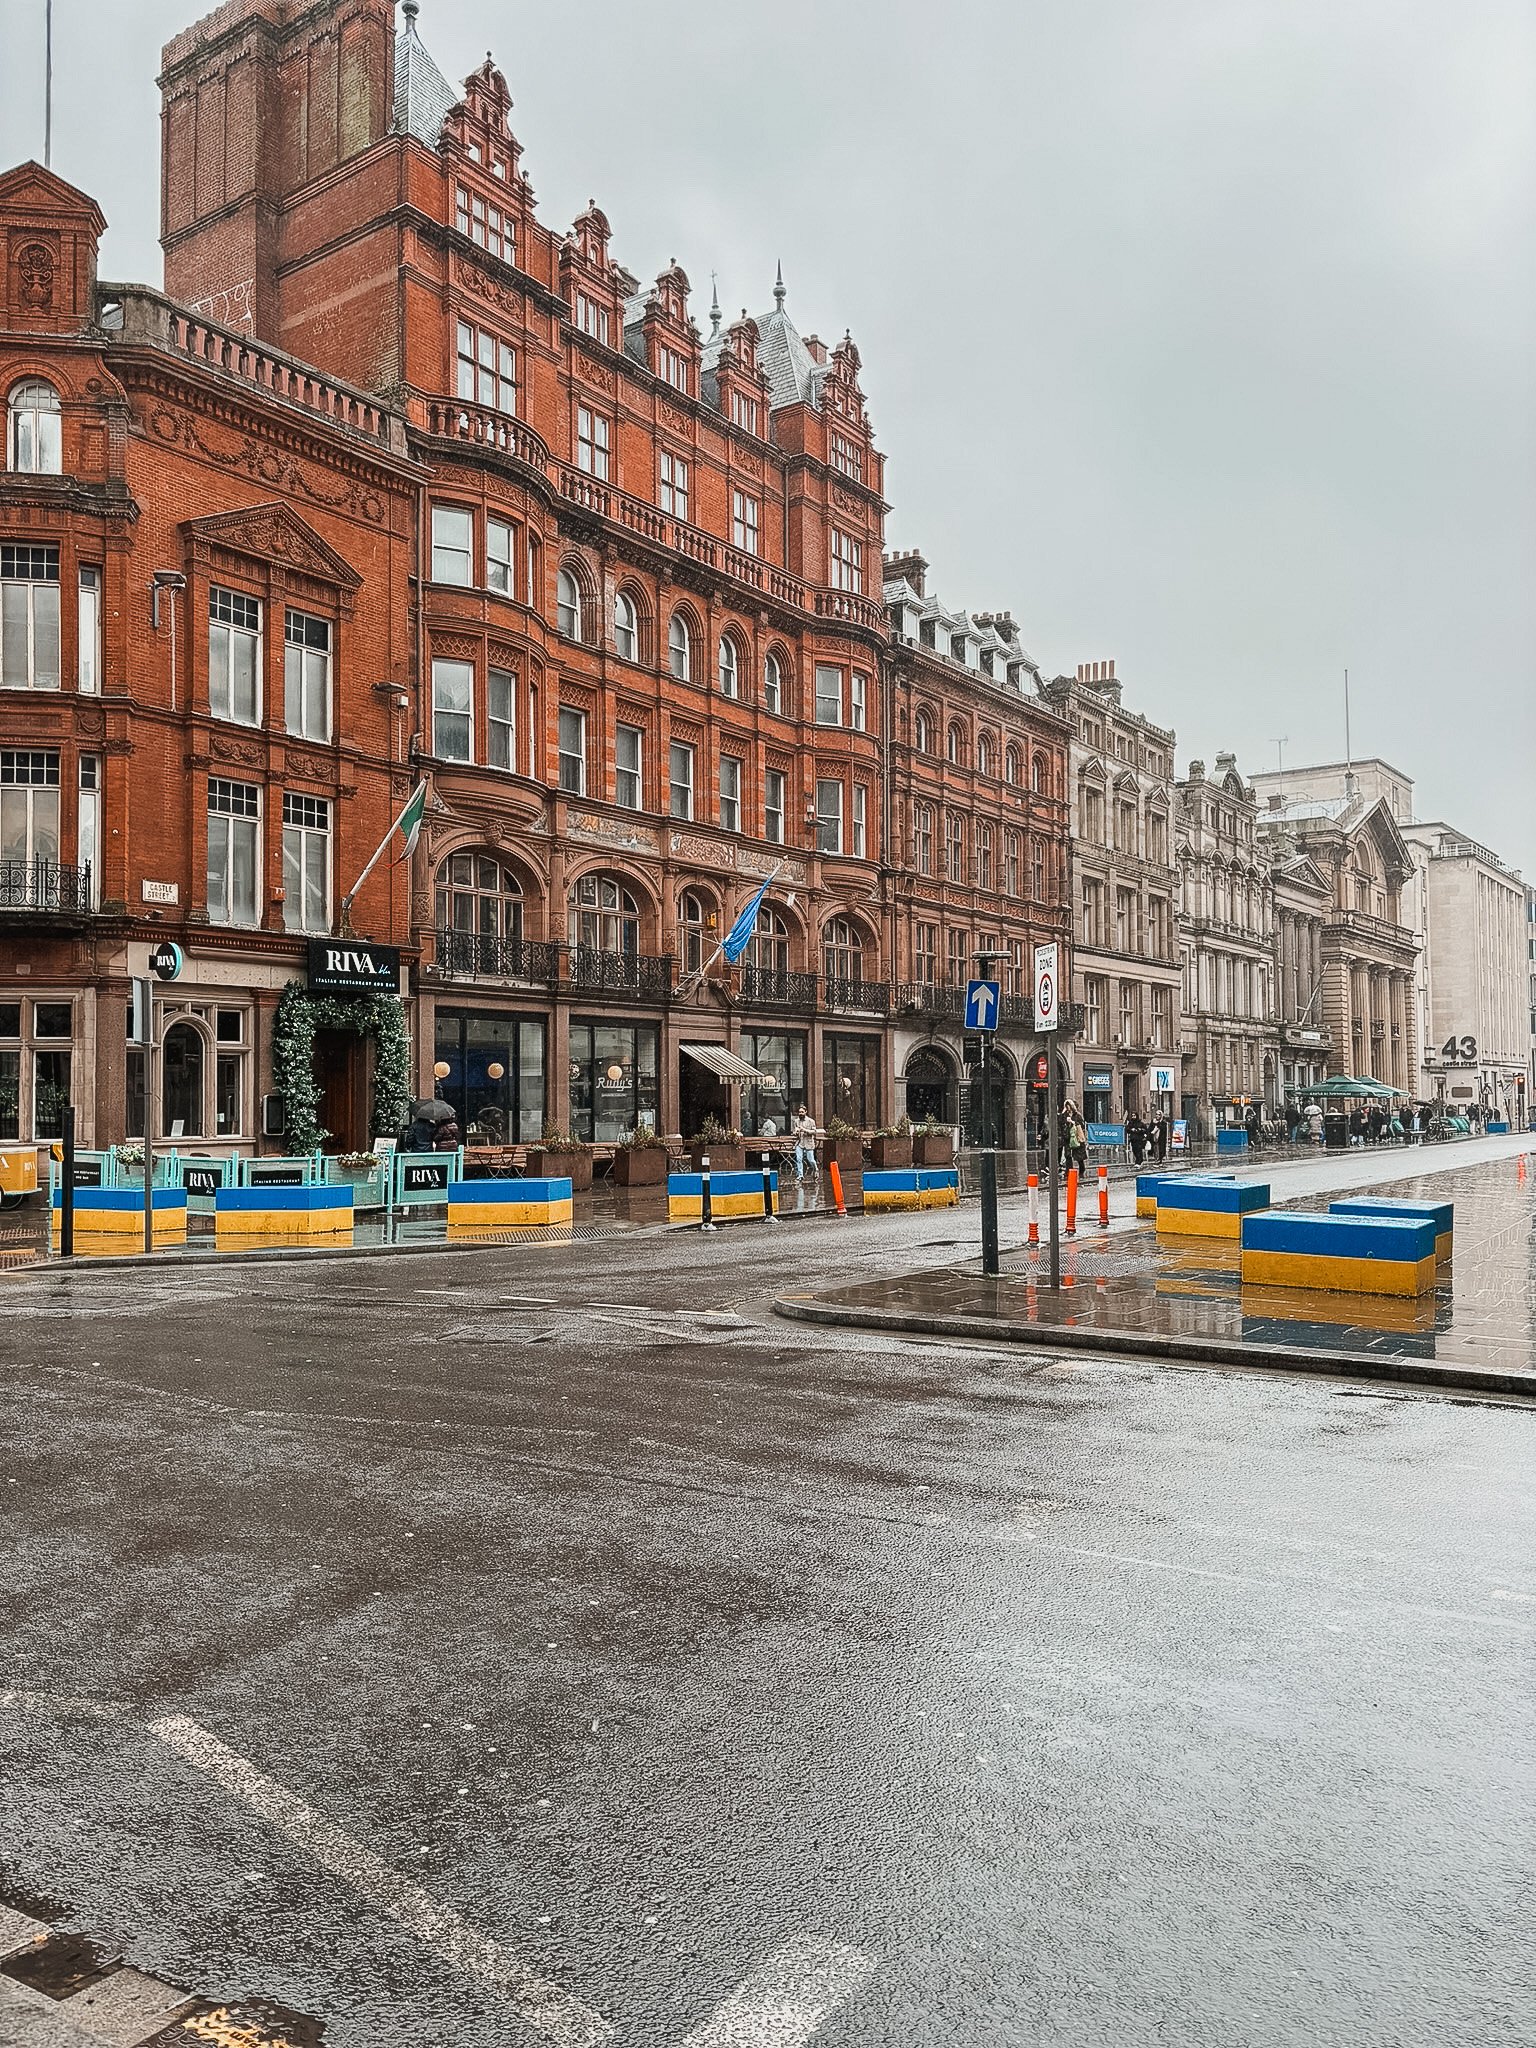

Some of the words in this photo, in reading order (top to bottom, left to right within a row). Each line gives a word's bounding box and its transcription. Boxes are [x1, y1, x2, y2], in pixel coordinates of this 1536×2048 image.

[150, 884, 173, 893] CASTLE
[147, 891, 170, 901] STREET
[157, 955, 175, 966] RIVA
[326, 950, 377, 974] RIVA
[1040, 956, 1052, 970] ZONE
[1442, 1036, 1477, 1060] 43
[595, 1077, 633, 1091] Rudy's
[189, 1172, 216, 1188] RIVA
[411, 1169, 441, 1183] RIVA
